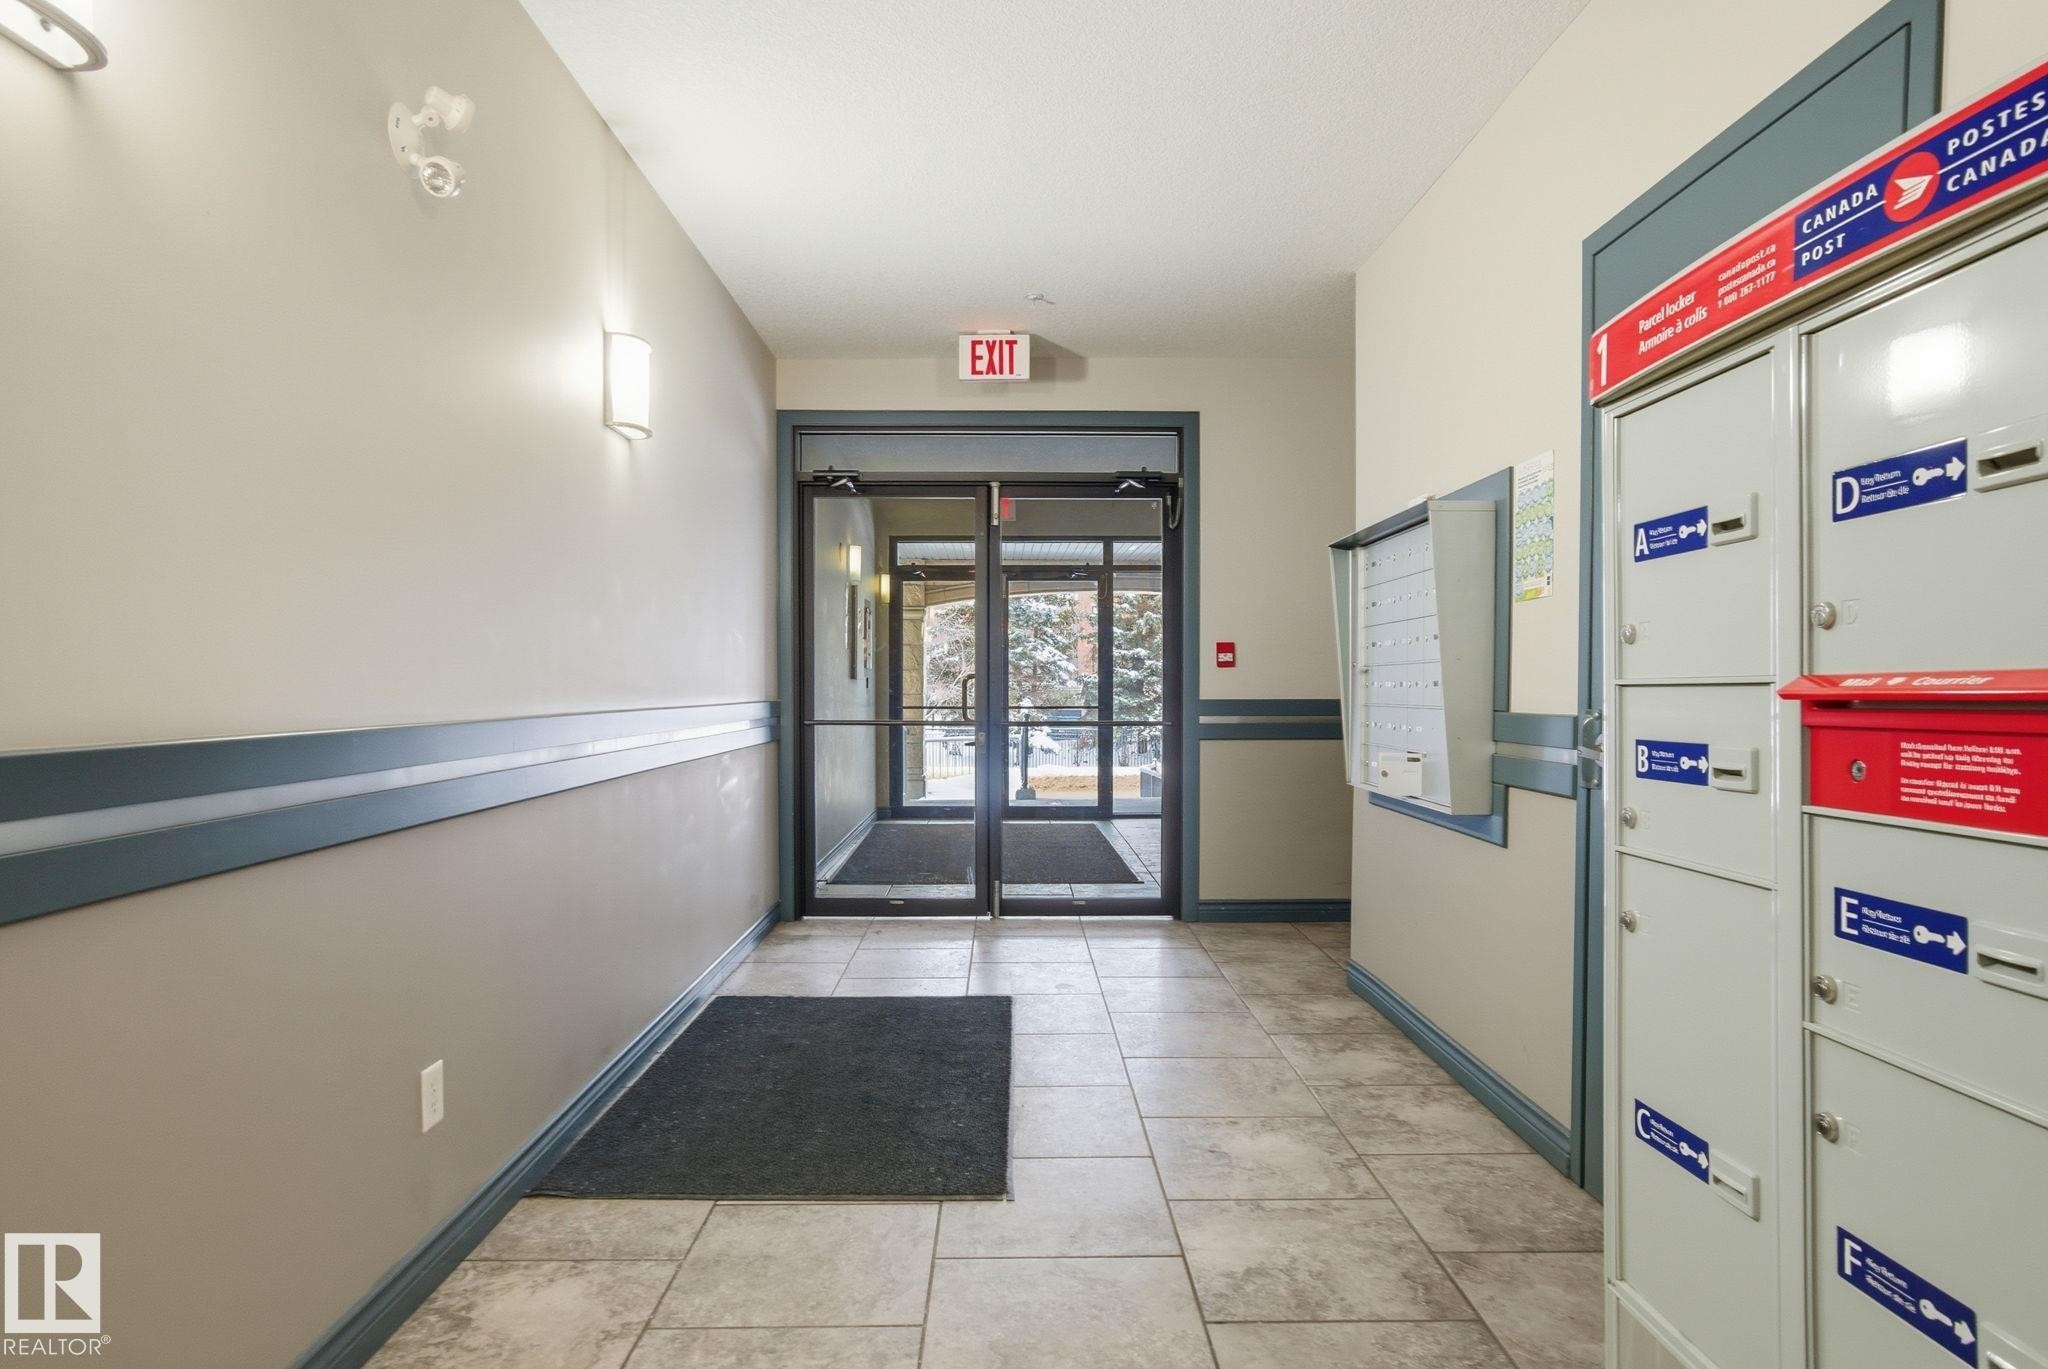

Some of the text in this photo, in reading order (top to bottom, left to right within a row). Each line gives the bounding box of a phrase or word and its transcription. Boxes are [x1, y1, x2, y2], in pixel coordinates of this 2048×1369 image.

[1947, 91, 2046, 156] POSTES
[1802, 183, 1879, 235] CANADA
[1718, 244, 1776, 282] canadapost.ca
[1801, 232, 1846, 266] POST
[1718, 259, 1776, 297] postescanada.ca
[1638, 291, 1697, 334] Parcel locker
[1638, 306, 1708, 355] Armoire à colis
[970, 340, 1018, 376] EXIT
[1597, 333, 1608, 387] 1
[1836, 475, 1860, 515] D
[1635, 527, 1650, 557] A
[1840, 674, 1995, 687] Mail Courrier
[1637, 745, 1649, 773] B
[1841, 896, 1860, 936] E
[1636, 1108, 1651, 1140] C
[1843, 1238, 1863, 1276] F
